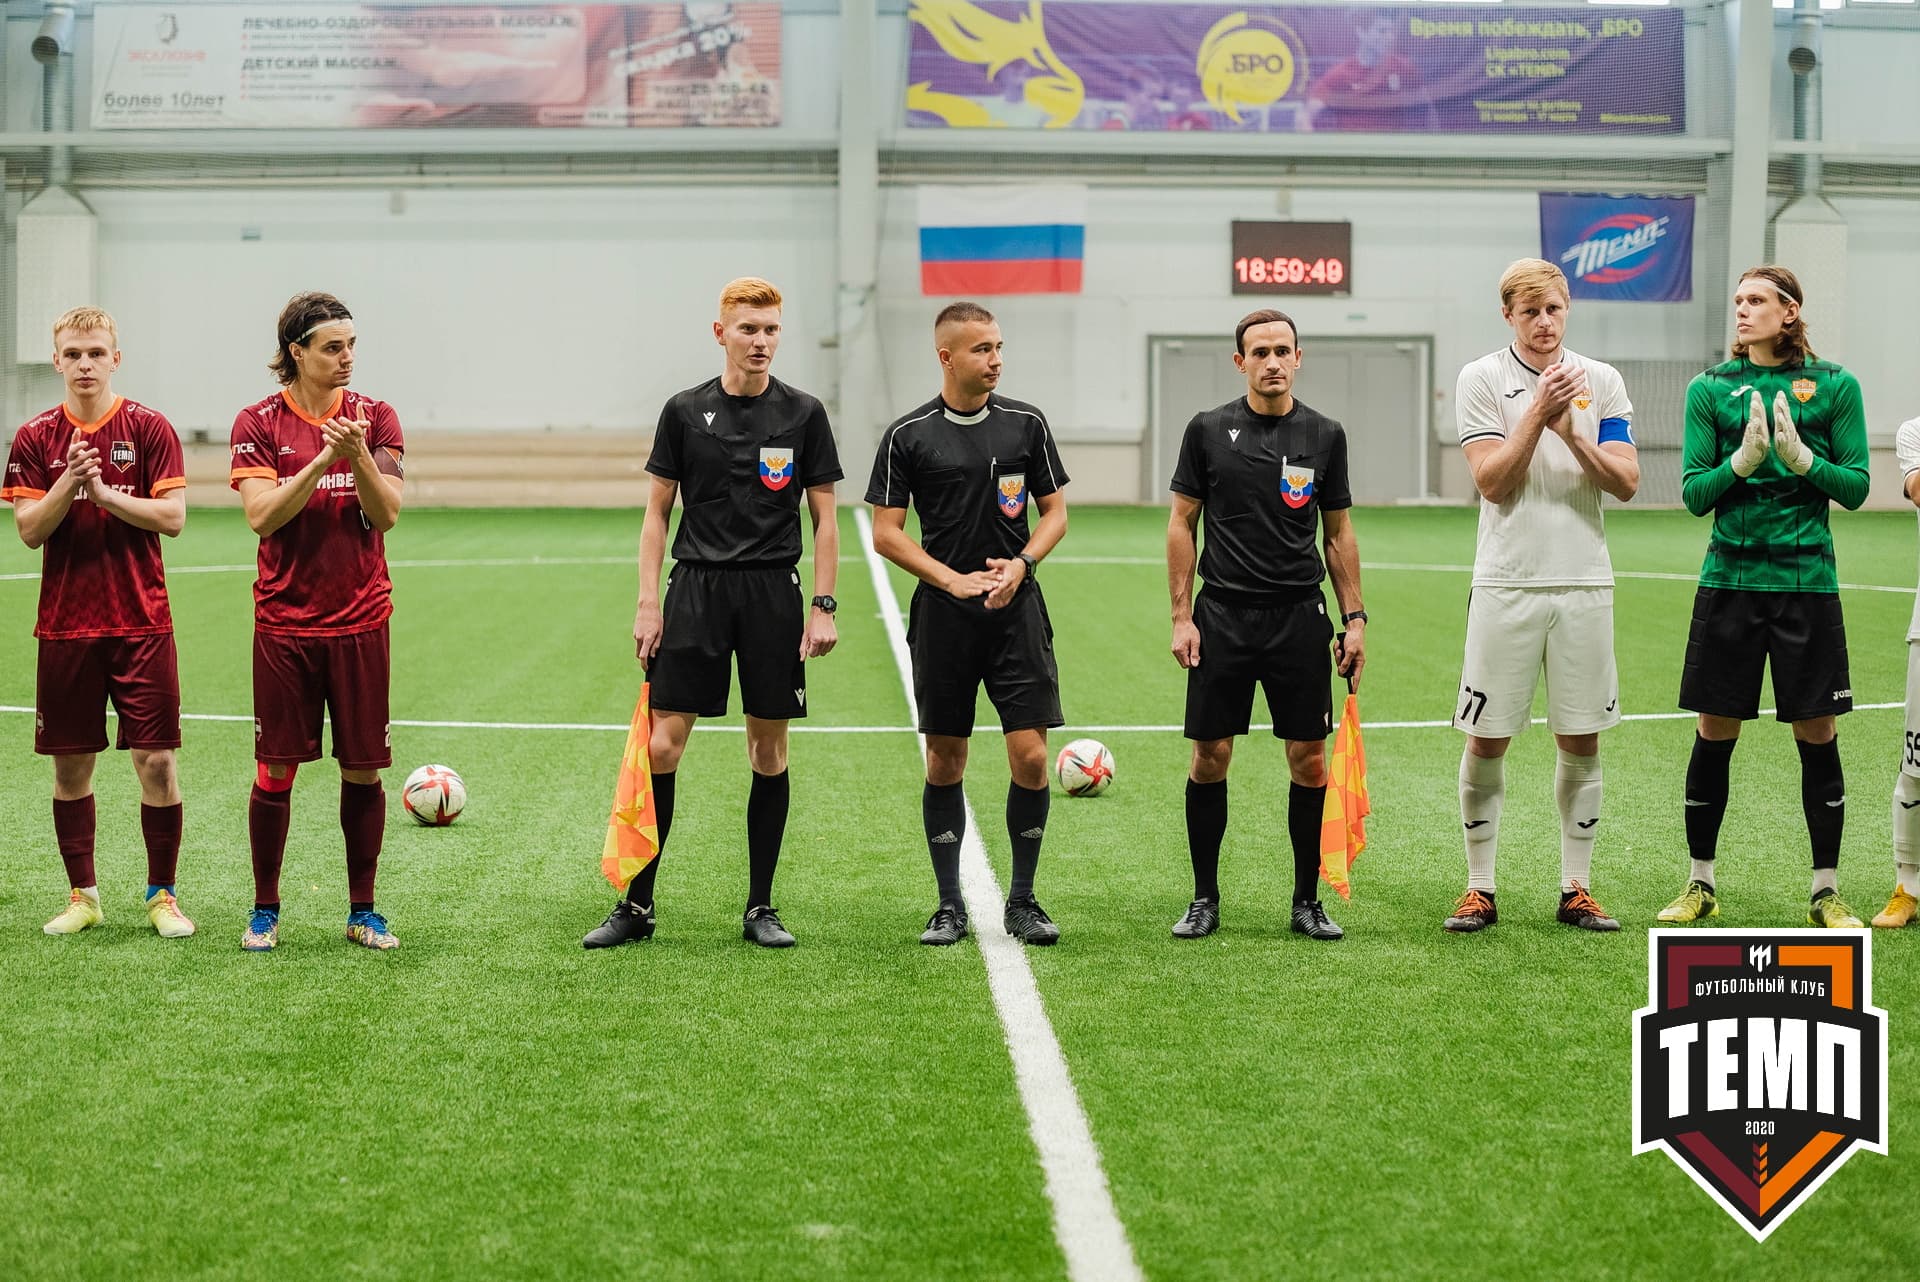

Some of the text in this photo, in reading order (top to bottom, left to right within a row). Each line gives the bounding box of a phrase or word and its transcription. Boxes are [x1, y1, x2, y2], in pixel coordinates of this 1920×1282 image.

[241, 54, 319, 71] ДЕТСКИЙ
[104, 91, 163, 108] более
[1460, 686, 1488, 726] 77
